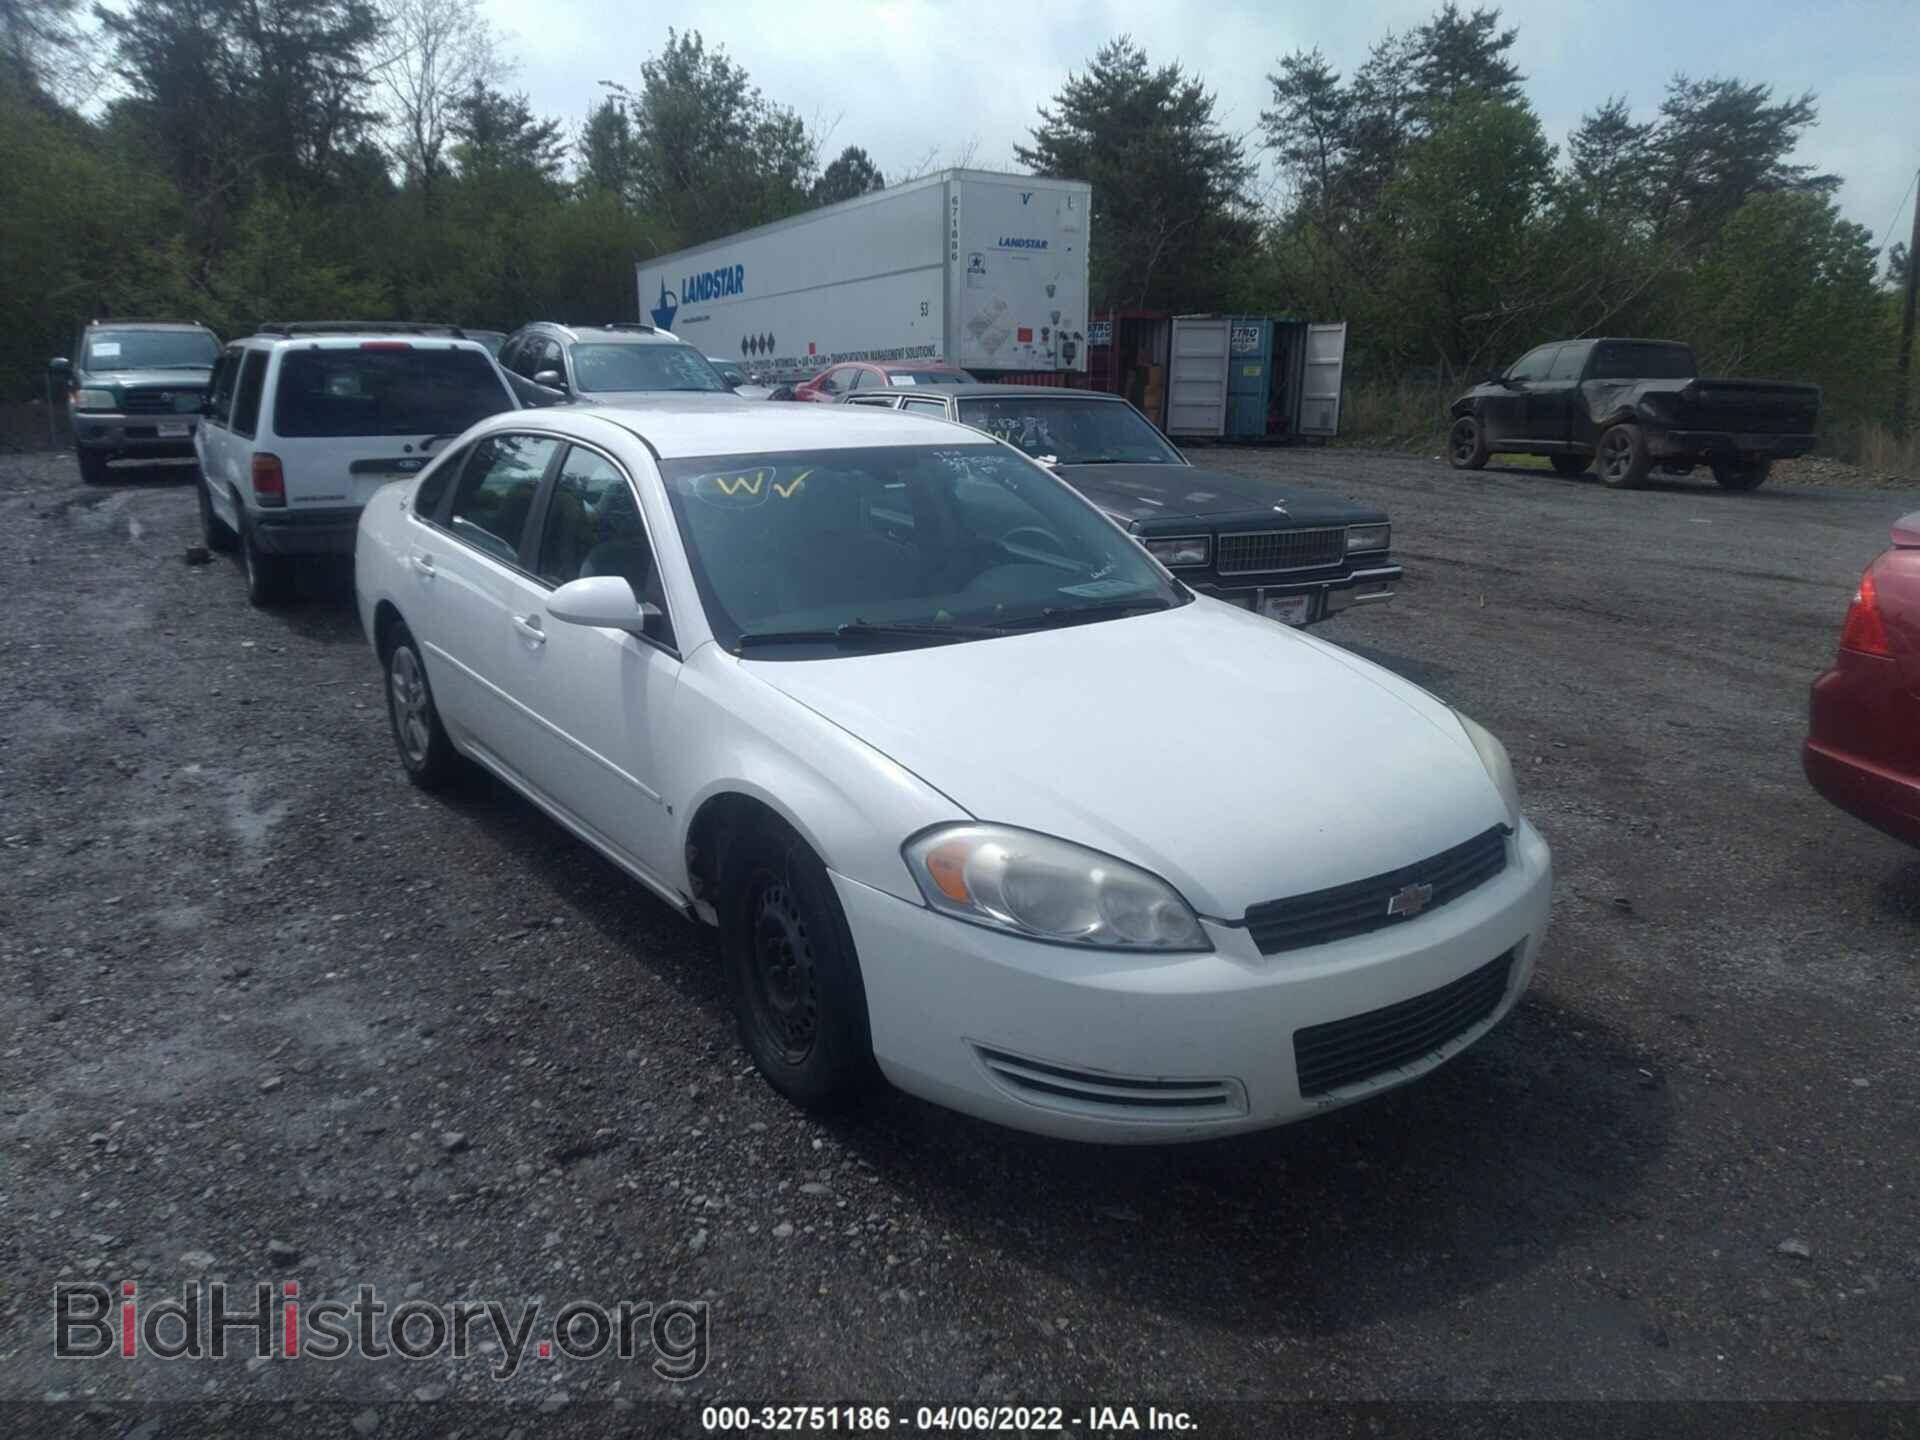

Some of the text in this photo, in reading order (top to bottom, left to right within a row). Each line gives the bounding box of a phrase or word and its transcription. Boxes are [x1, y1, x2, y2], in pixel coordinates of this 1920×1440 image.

[998, 236, 1049, 250] LANDSTAR
[682, 264, 744, 304] LANDSTAR
[905, 344, 936, 358] SOLUTIONS
[717, 472, 764, 495] W
